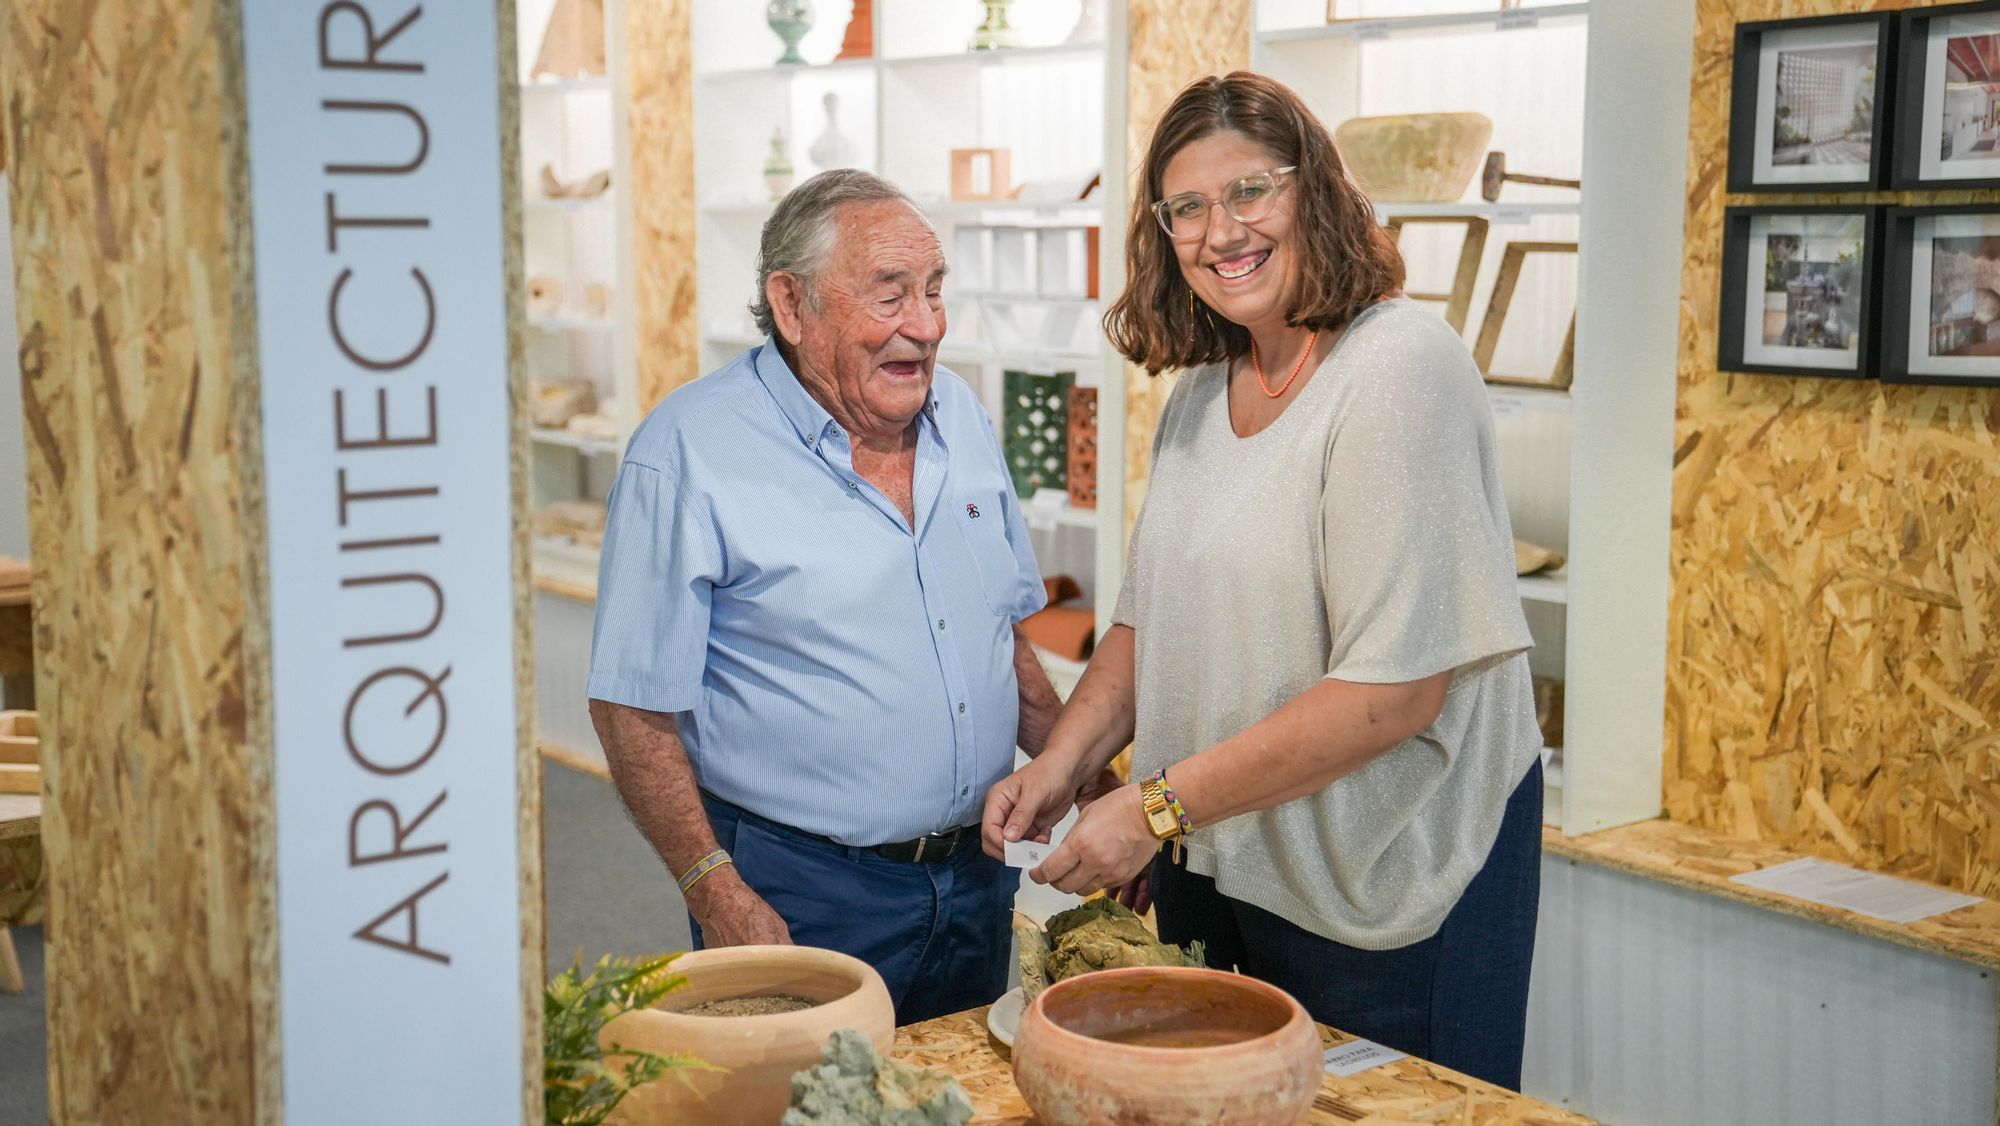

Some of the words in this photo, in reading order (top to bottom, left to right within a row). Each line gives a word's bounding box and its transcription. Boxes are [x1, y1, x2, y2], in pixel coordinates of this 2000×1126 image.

[316, 0, 451, 967] ARQUITECTUR
[1324, 1054, 1350, 1065] ARRO
[1350, 1046, 1374, 1056] PARA
[1335, 1051, 1381, 1068] LADRILLOS
